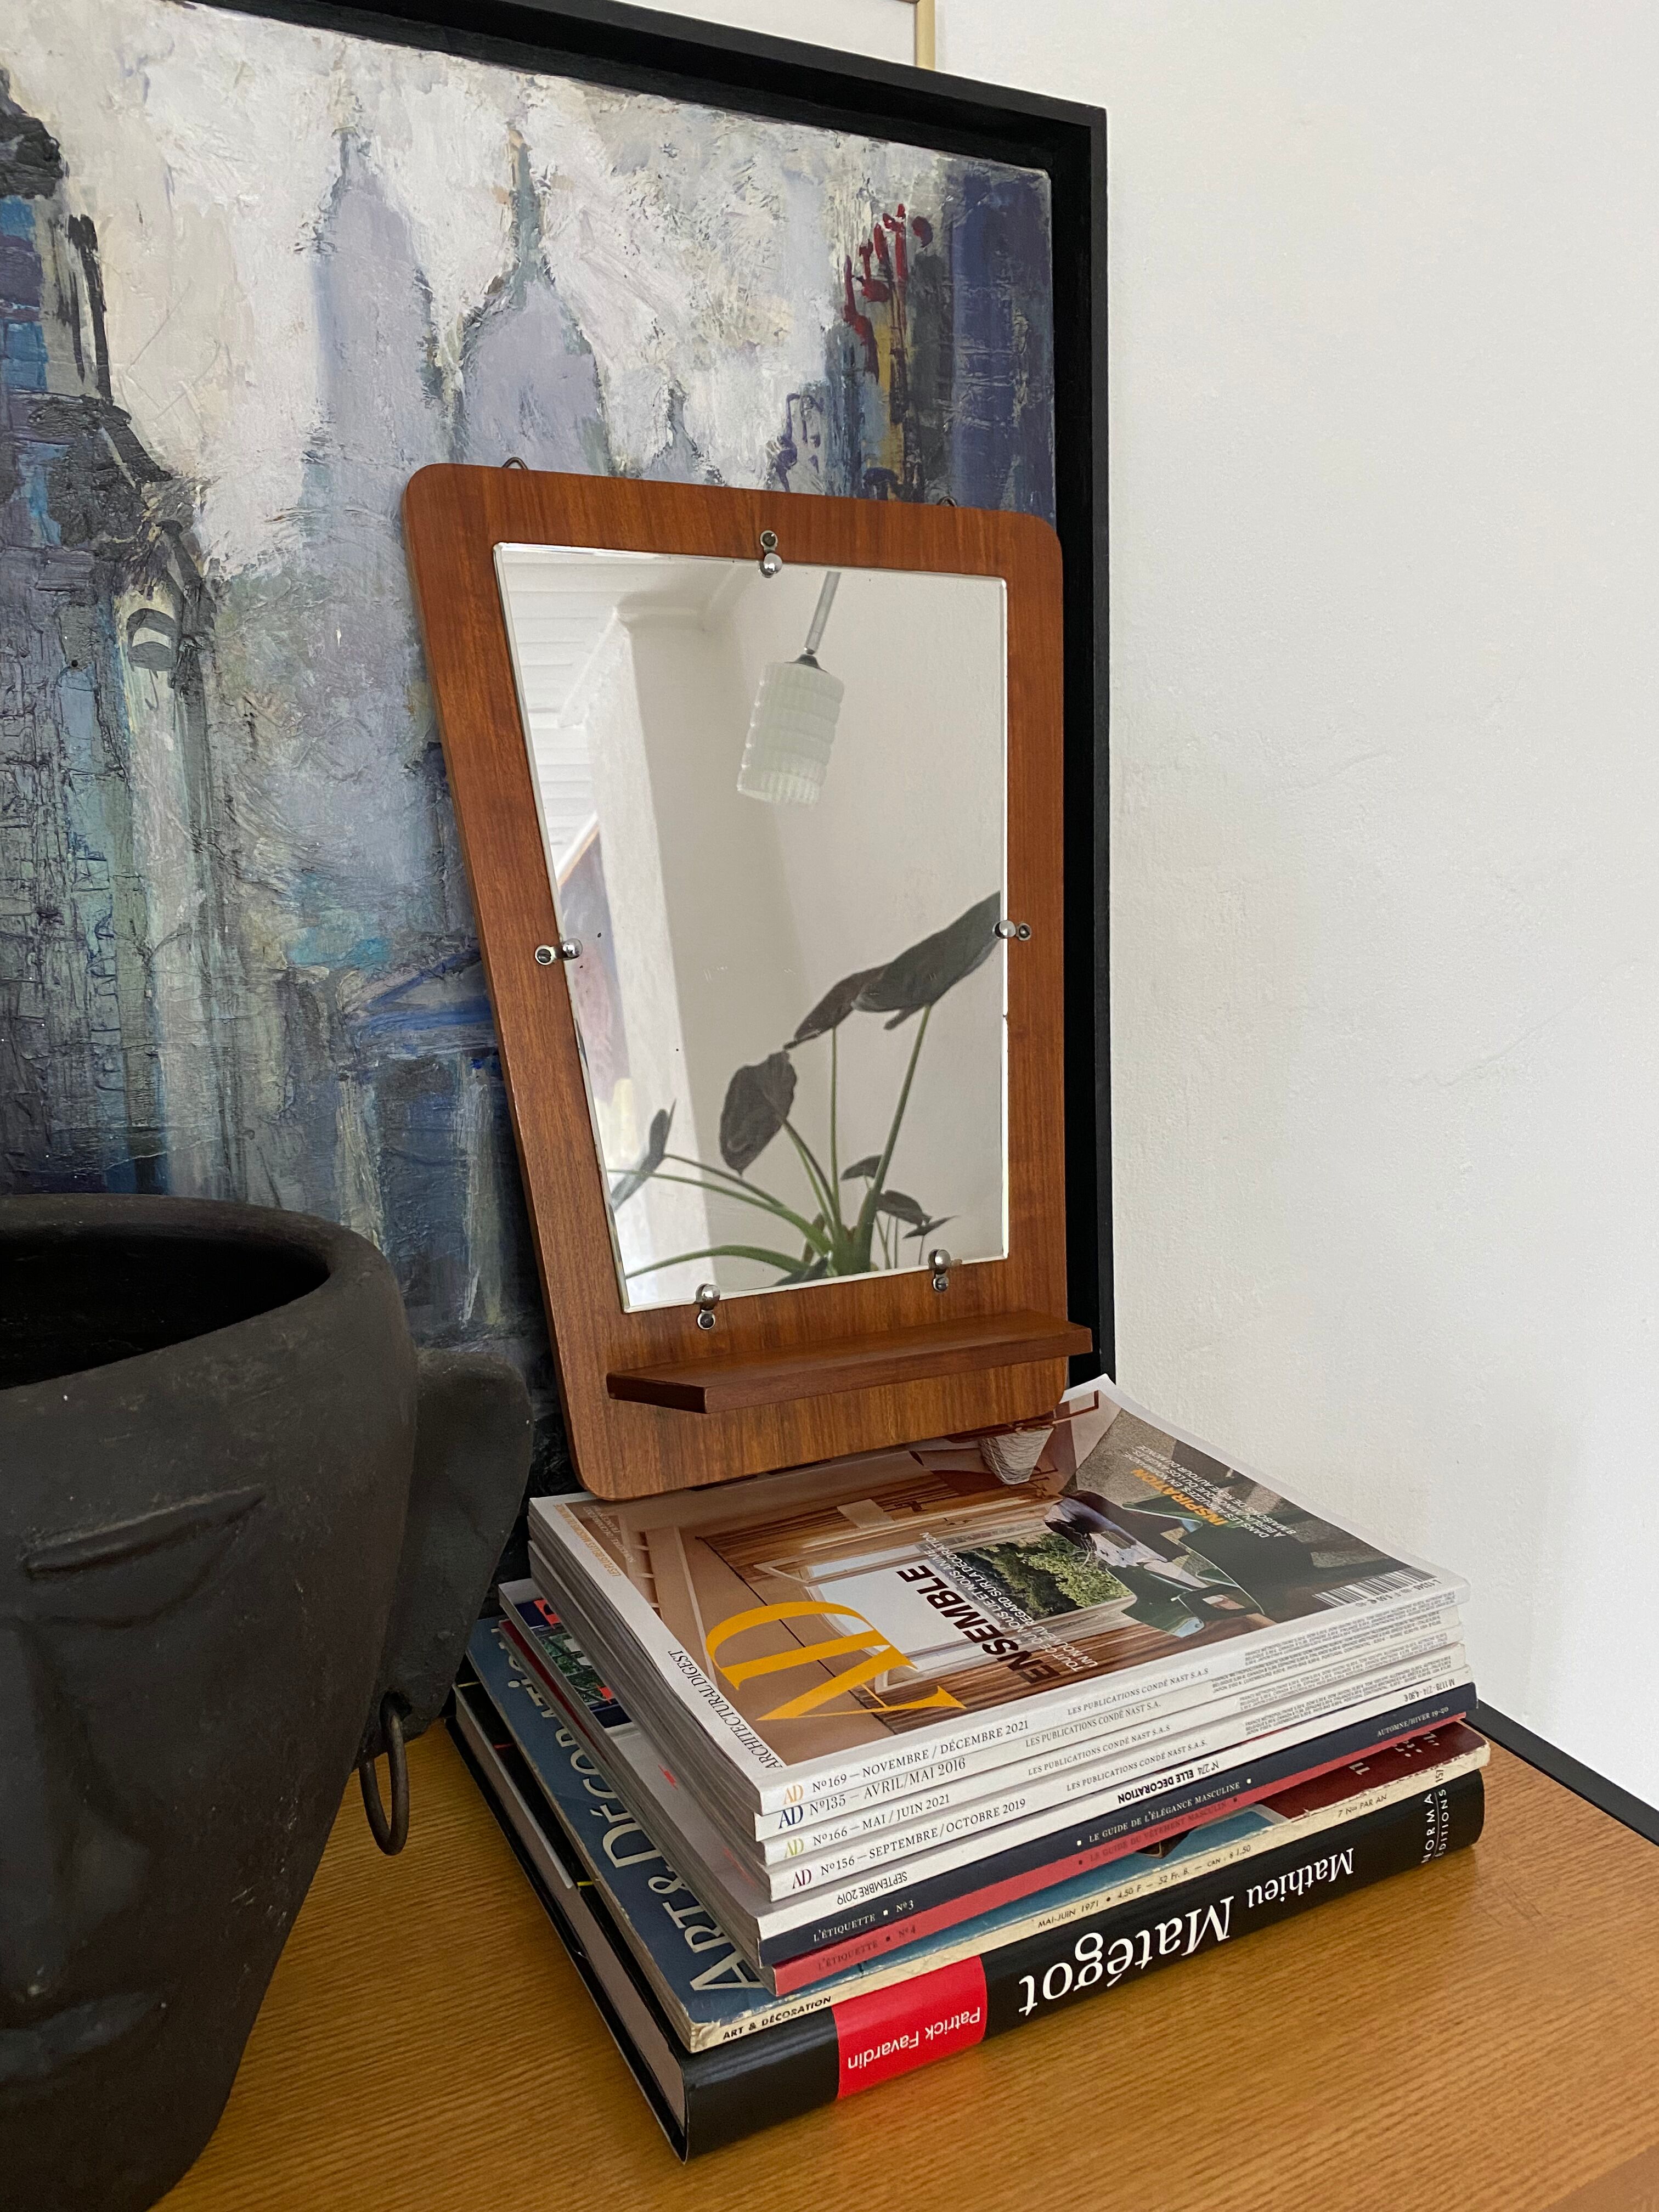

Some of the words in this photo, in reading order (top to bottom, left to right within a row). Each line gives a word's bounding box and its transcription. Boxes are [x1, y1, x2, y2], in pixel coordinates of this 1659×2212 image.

[1167, 1459, 1181, 1469] DU
[1167, 1469, 1187, 1480] LOS
[1178, 1463, 1213, 1487] AUTOUR
[1166, 1478, 1183, 1487] EN
[1186, 1480, 1199, 1488] OU
[1131, 1469, 1229, 1526] INSPIRATION
[1233, 1498, 1248, 1508] DE
[1224, 1513, 1244, 1525] LES
[1241, 1523, 1271, 1538] DANS
[1245, 1506, 1289, 1531] MAISONS
[949, 1570, 979, 1591] NOUS
[968, 1571, 985, 1582] LA
[980, 1582, 1002, 1596] SUR
[972, 1590, 988, 1600] ET
[983, 1598, 1002, 1613] LIE
[997, 1613, 1028, 1633] NOUS
[998, 1596, 1038, 1626] REGARD
[896, 1564, 1061, 1684] ENSEMBLE
[1022, 1632, 1043, 1645] QUI
[1033, 1626, 1084, 1656] NOUVEAU
[1039, 1644, 1057, 1654] CE
[668, 1650, 708, 1688] DIGEST
[706, 1601, 967, 1720] AD
[1051, 1654, 1083, 1672] TOUT
[1078, 1655, 1098, 1668] UN
[1068, 1707, 1081, 1716] LES
[1083, 1688, 1140, 1712] PUBLICATIONS
[1142, 1679, 1169, 1694] CONDÉ
[1169, 1673, 1189, 1684] NAST
[698, 1685, 783, 1769] ARCHITECTURAL
[1025, 1736, 1040, 1747] LES
[1042, 1719, 1097, 1743] PUBLICATIONS
[1098, 1709, 1124, 1725] CONDÉ
[1126, 1705, 1145, 1717] NAST
[1378, 1712, 1430, 1737] AUTOMNE/HIVER
[783, 1784, 804, 1805] AD
[862, 1749, 929, 1778] NOVEMBRE
[940, 1728, 1003, 1754] DÉCEMBRE
[1005, 1720, 1028, 1735] 2021
[1028, 1766, 1042, 1775] LES
[1044, 1746, 1101, 1771] PUBLICATIONS
[1103, 1737, 1130, 1752] CONDÉ
[1131, 1731, 1150, 1742] NAST
[1066, 1781, 1080, 1791] LES
[1082, 1762, 1138, 1786] PUBLICATIONS
[1139, 1752, 1166, 1767] CONDÉ
[1167, 1746, 1187, 1758] NAST
[1177, 1769, 1194, 1783] ELLE
[778, 1805, 804, 1829] AD
[938, 1757, 966, 1776] 2016
[1360, 1798, 1373, 1809] PAR
[1376, 1795, 1387, 1803] AN
[1089, 1833, 1099, 1843] LE
[1102, 1822, 1128, 1837] GUIDE
[1131, 1818, 1142, 1827] DE
[1195, 1782, 1240, 1804] MASCULINE
[784, 1837, 804, 1858] AD
[862, 1814, 885, 1830] MAI
[897, 1802, 923, 1820] JUIN
[926, 1793, 950, 1810] 2021
[1090, 1853, 1101, 1861] LE
[1103, 1843, 1129, 1856] GUIDE
[1188, 1802, 1227, 1820] MASCULIN
[1421, 1793, 1436, 1864] NORMA
[792, 1869, 812, 1889] AD
[1003, 1798, 1026, 1814] 2019
[859, 1871, 908, 1897] SEPTEMBRE
[1246, 1848, 1354, 1909] Mathieu
[837, 1889, 858, 1905] 2019
[909, 1900, 914, 1910] 3
[1037, 1908, 1076, 1928] MAI-JUIN
[1081, 1900, 1099, 1913] 1971
[1136, 1884, 1142, 1893] F
[1159, 1876, 1168, 1885] 52
[911, 1926, 916, 1934] 4
[662, 1901, 766, 1991] ART
[1018, 1895, 1235, 2016] Matégot
[723, 2026, 743, 2040] ART
[748, 2022, 757, 2031] &
[925, 2007, 981, 2040] Patrick
[848, 2030, 919, 2069] Favardin
